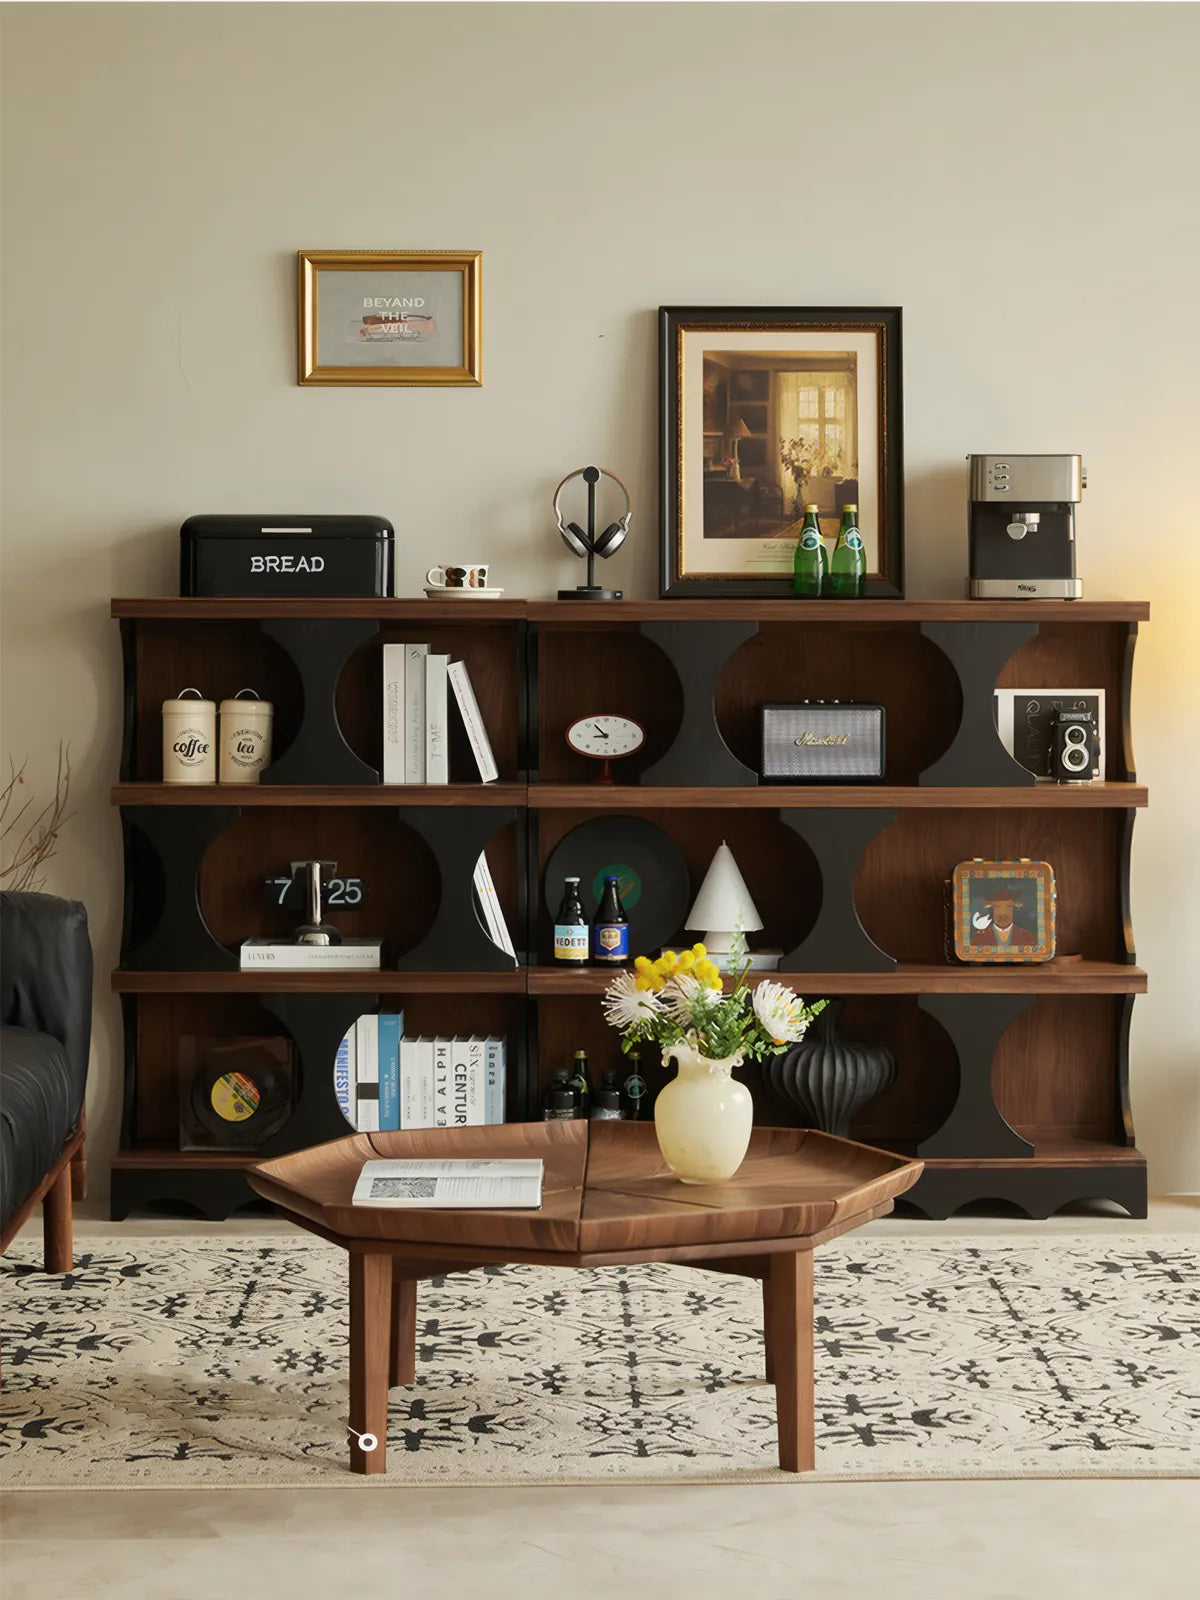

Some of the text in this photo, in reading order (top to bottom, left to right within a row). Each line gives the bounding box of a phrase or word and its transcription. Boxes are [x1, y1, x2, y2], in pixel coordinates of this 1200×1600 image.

[363, 297, 425, 308] BEYAND
[379, 311, 410, 321] THE
[250, 555, 325, 573] BREAD
[1025, 700, 1041, 768] QUALIT
[172, 738, 210, 758] coffee
[236, 740, 255, 754] tea
[274, 878, 362, 905] 7 25
[454, 1063, 468, 1127] CENTUR
